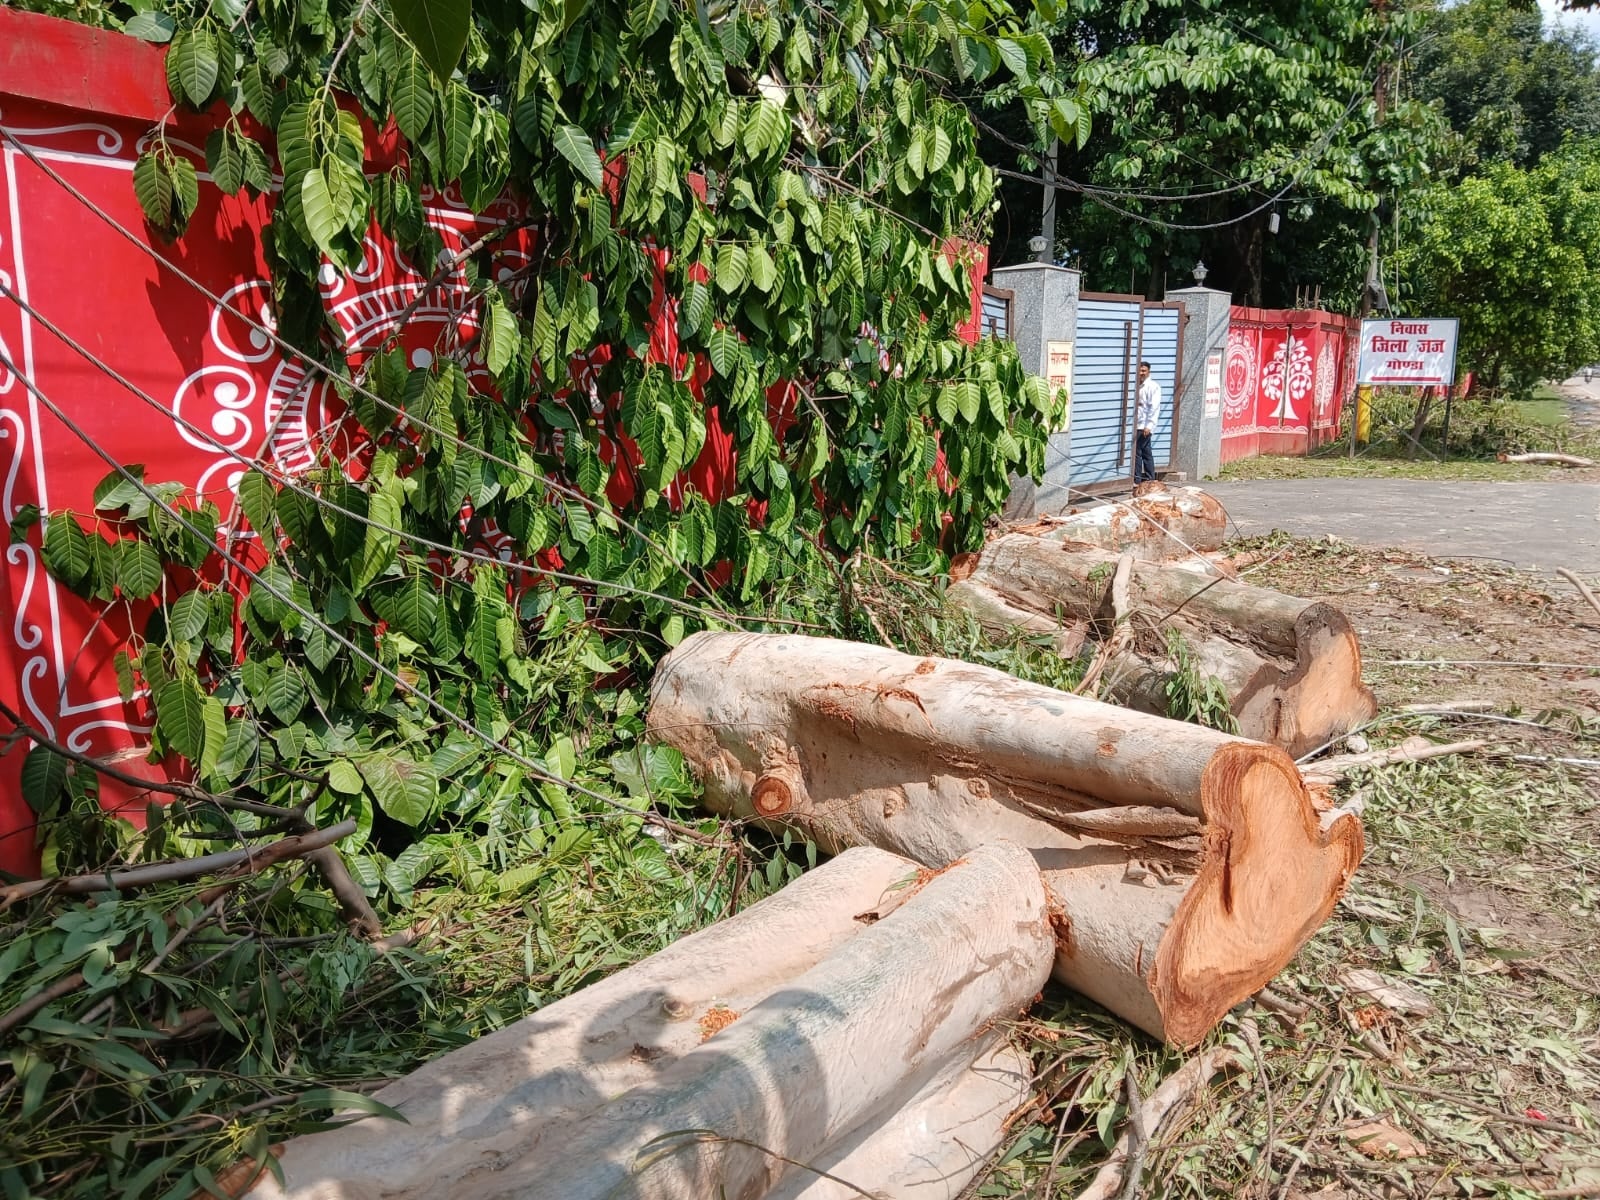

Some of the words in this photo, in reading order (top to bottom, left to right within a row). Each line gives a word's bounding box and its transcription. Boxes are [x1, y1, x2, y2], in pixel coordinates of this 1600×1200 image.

[1390, 321, 1429, 334] निवास
[1371, 336, 1408, 352] जिला
[1417, 340, 1446, 353] जज
[1386, 358, 1424, 370] गोण्डा
